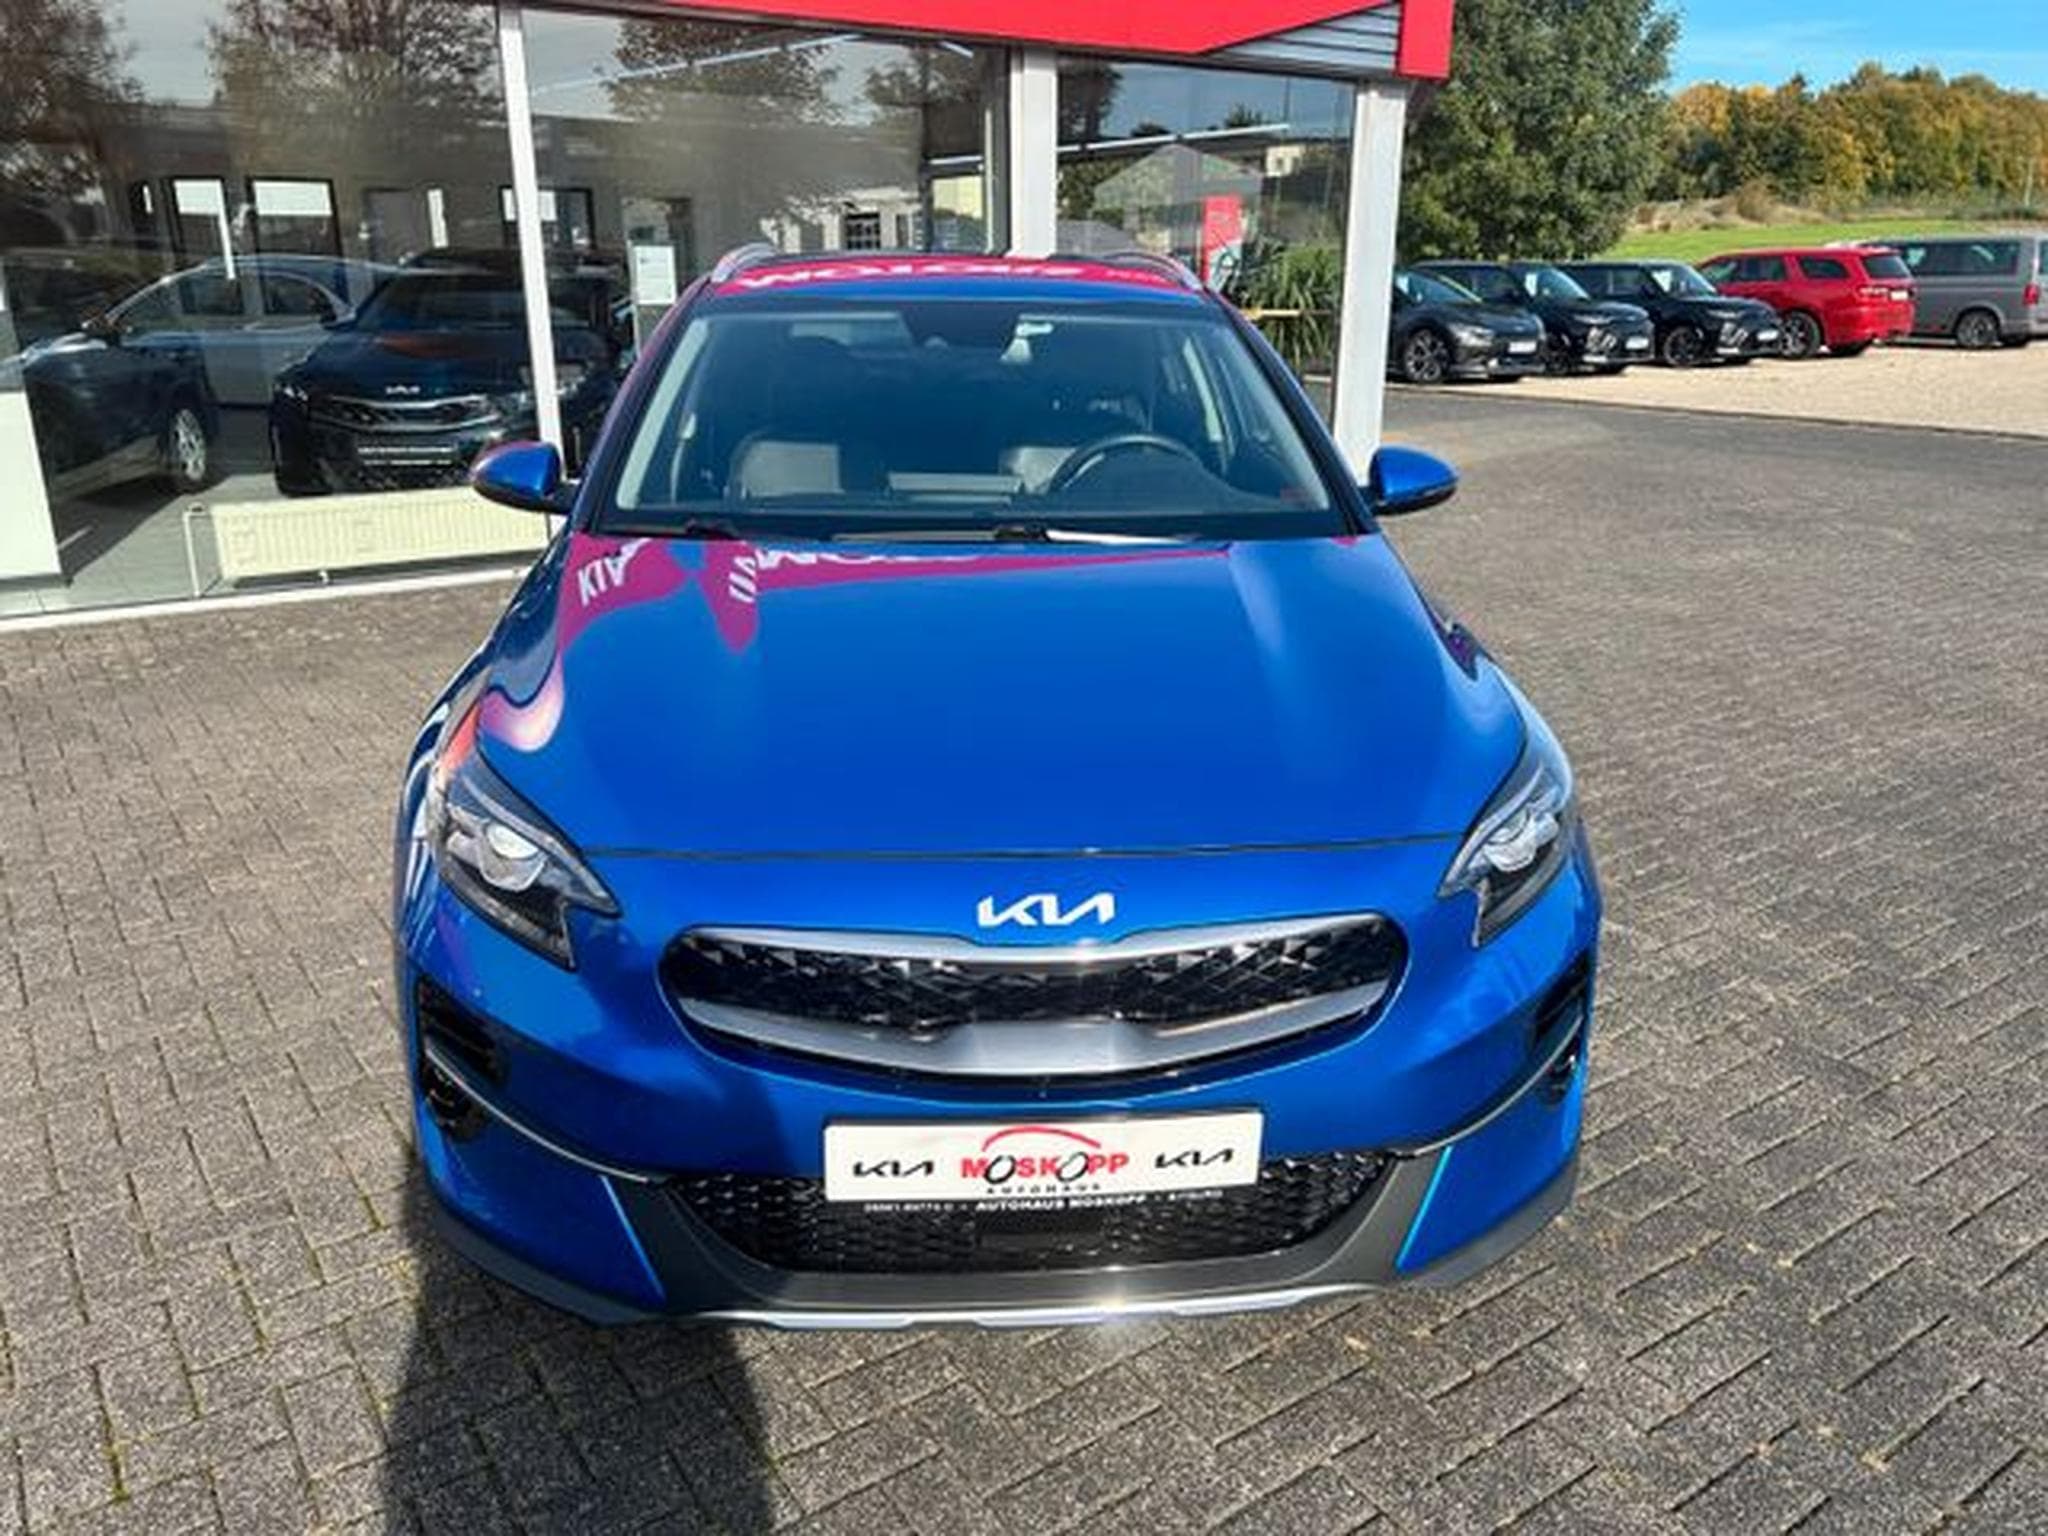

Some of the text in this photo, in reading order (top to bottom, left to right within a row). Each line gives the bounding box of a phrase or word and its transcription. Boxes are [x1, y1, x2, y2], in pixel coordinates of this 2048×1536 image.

[977, 892, 1115, 928] KIA
[1155, 1147, 1234, 1168] KIA
[853, 1160, 934, 1177] KIA
[961, 1152, 1130, 1185] MOSKOPP
[986, 1183, 1100, 1195] AUTOHAUS
[976, 1194, 1147, 1212] AUTOHAUS MOSKOPP
